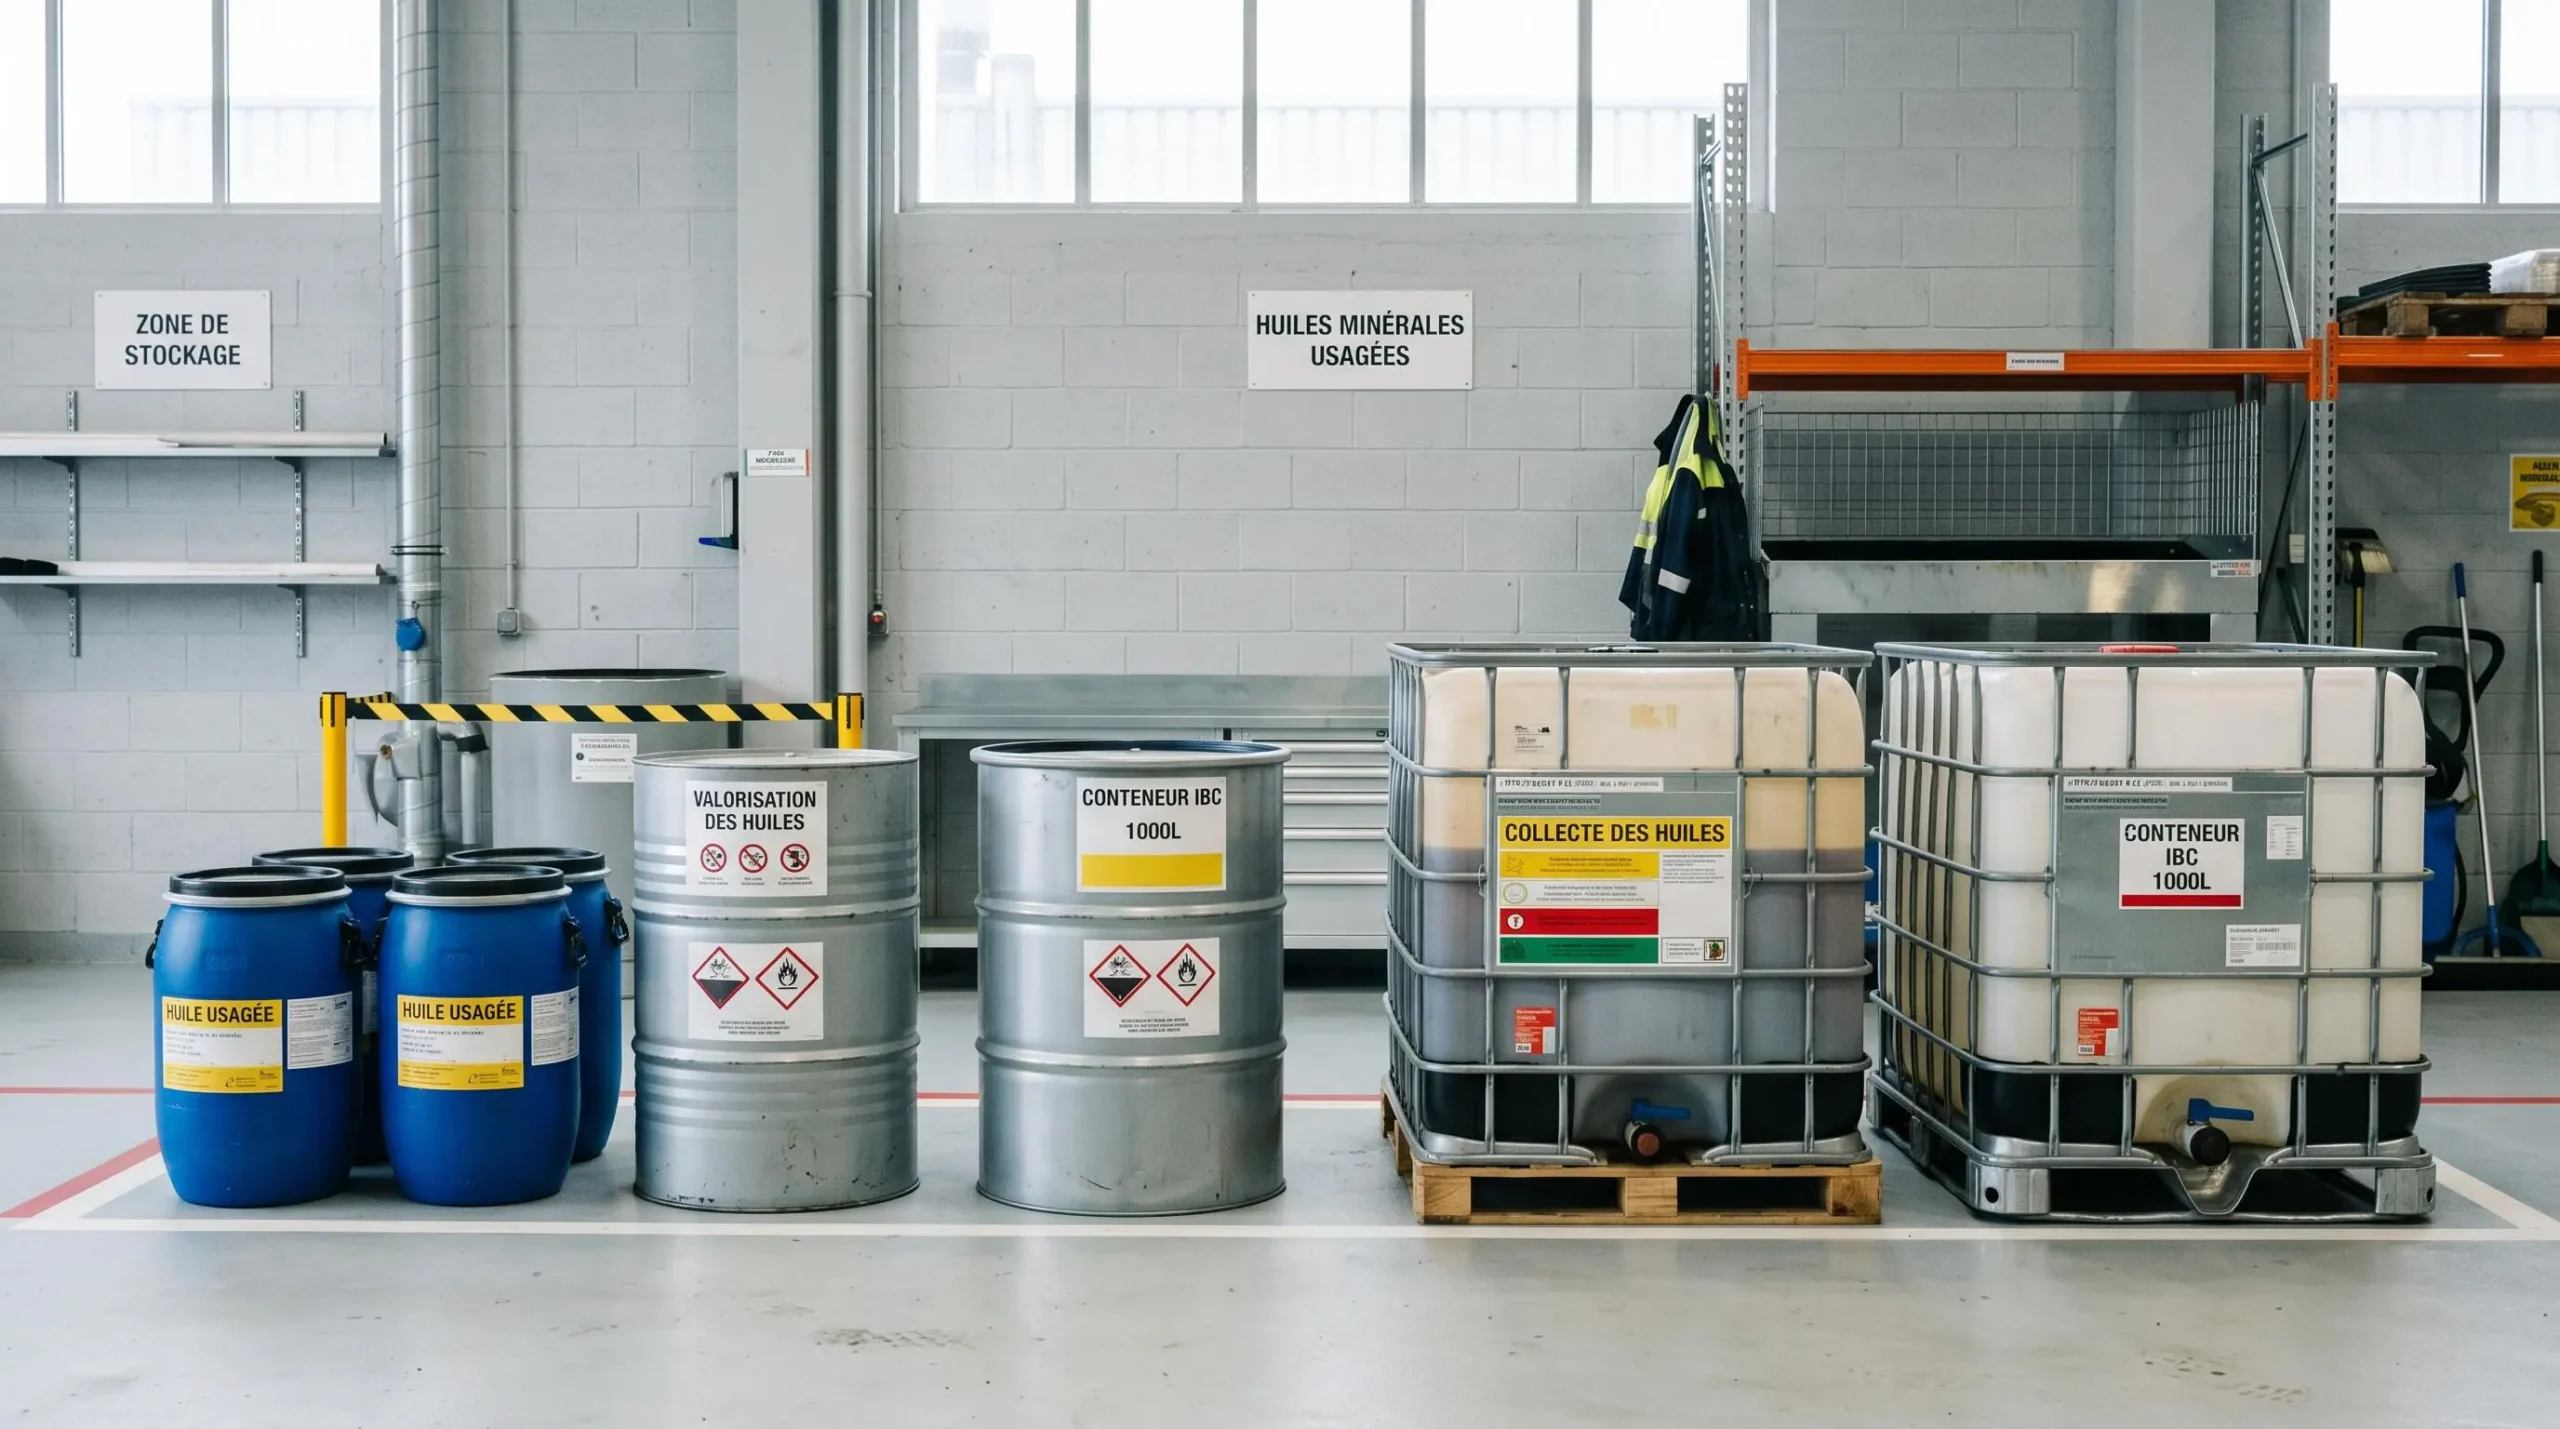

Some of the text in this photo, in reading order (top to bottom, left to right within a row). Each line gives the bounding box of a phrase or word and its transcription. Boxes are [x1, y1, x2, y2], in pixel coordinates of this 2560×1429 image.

[137, 314, 228, 334] ZONE DE
[1257, 310, 1464, 335] HUILES MINÉRALES
[126, 345, 240, 365] STOCKAGE
[1312, 341, 1409, 366] USAGÉES
[694, 791, 815, 808] VALORISATION
[1083, 788, 1221, 806] CONTENEUR IBC
[706, 814, 804, 830] DES HUILES
[1127, 822, 1181, 839] 1000L
[1506, 823, 1724, 842] COLLECTE DES HUILES
[2125, 824, 2239, 842] CONTENEUR
[2167, 848, 2197, 866] IBC
[2154, 872, 2210, 890] 1000L
[167, 1003, 273, 1023] HUILE USAGÉE
[404, 1000, 516, 1020] HUILE USAGÉE
